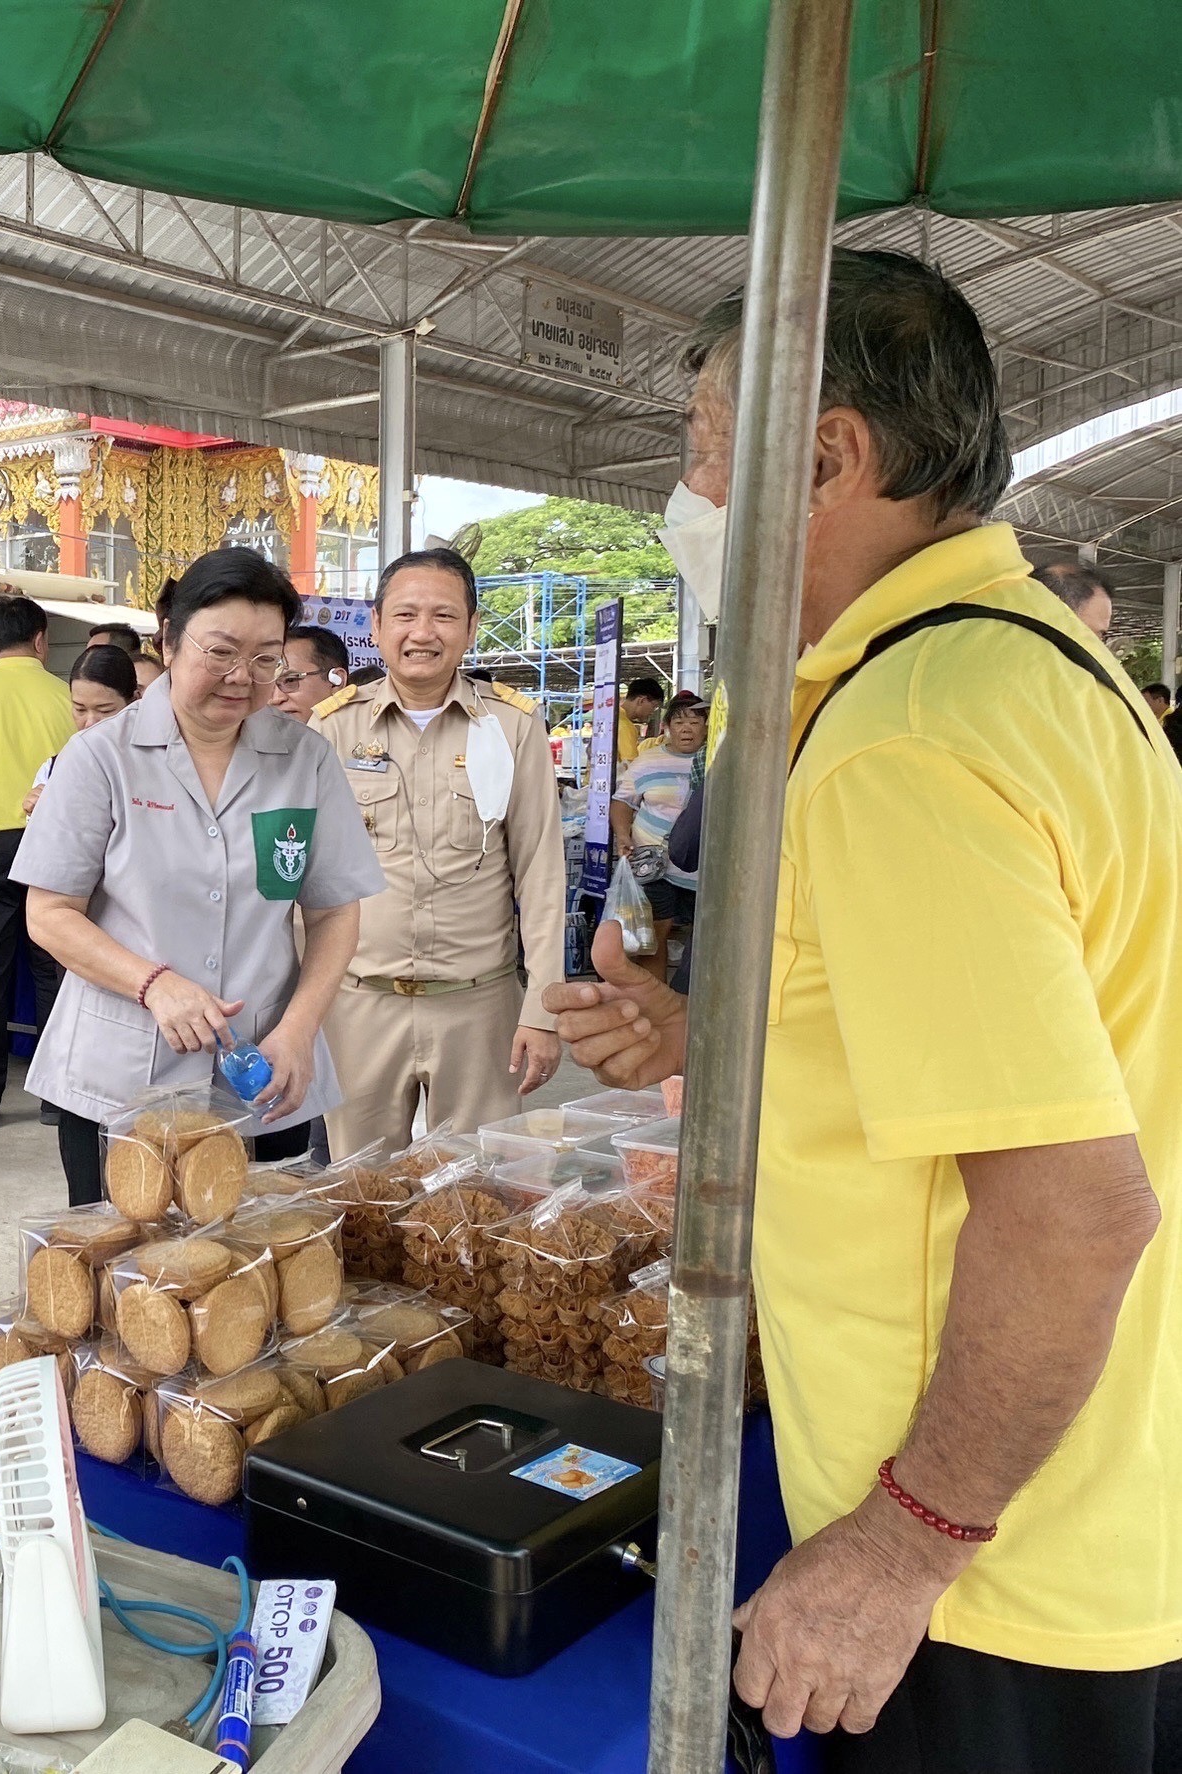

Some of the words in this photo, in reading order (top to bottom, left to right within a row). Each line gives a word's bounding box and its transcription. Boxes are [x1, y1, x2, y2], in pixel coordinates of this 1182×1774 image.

[556, 296, 596, 323] อนุสรณ์
[532, 319, 574, 347] นายแสง
[270, 1584, 295, 1639] OTOP
[254, 1646, 293, 1695] 500
